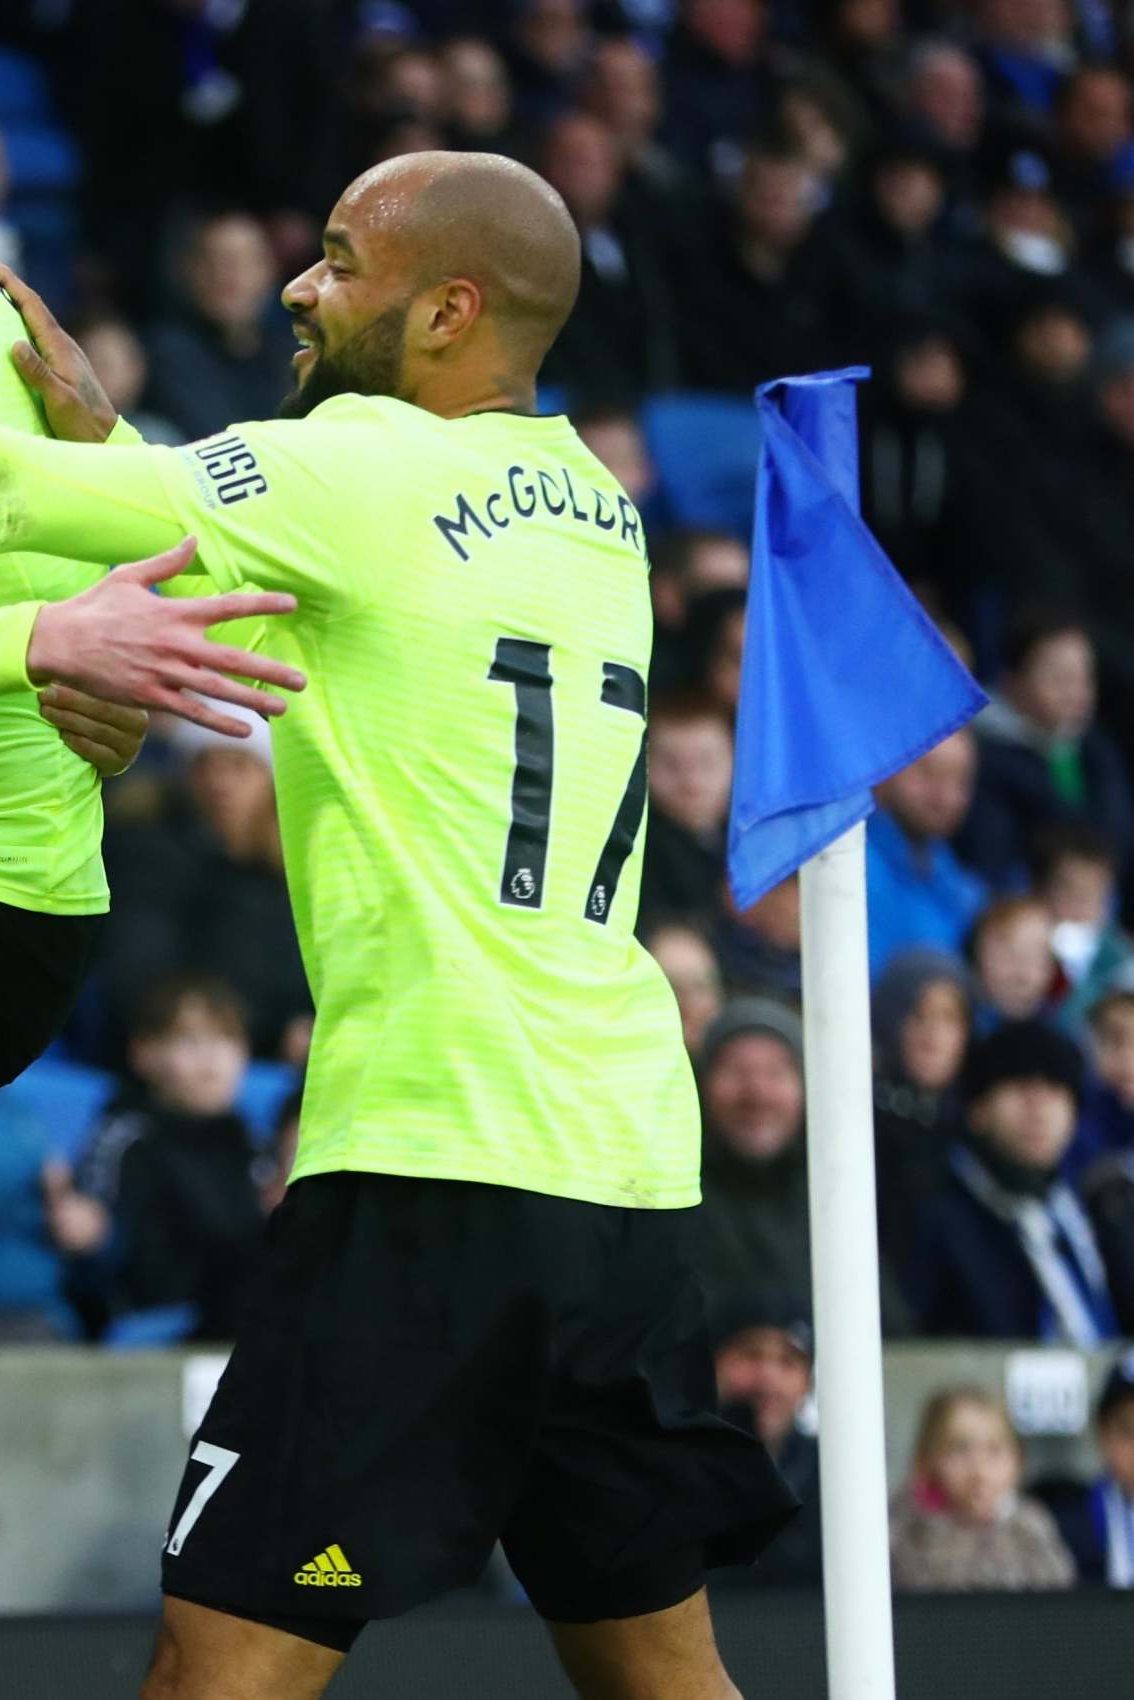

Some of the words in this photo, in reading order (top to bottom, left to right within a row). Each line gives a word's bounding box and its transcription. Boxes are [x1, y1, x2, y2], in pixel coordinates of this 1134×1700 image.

[195, 436, 268, 505] USG
[486, 637, 648, 926] 17
[294, 1571, 362, 1587] adidas
